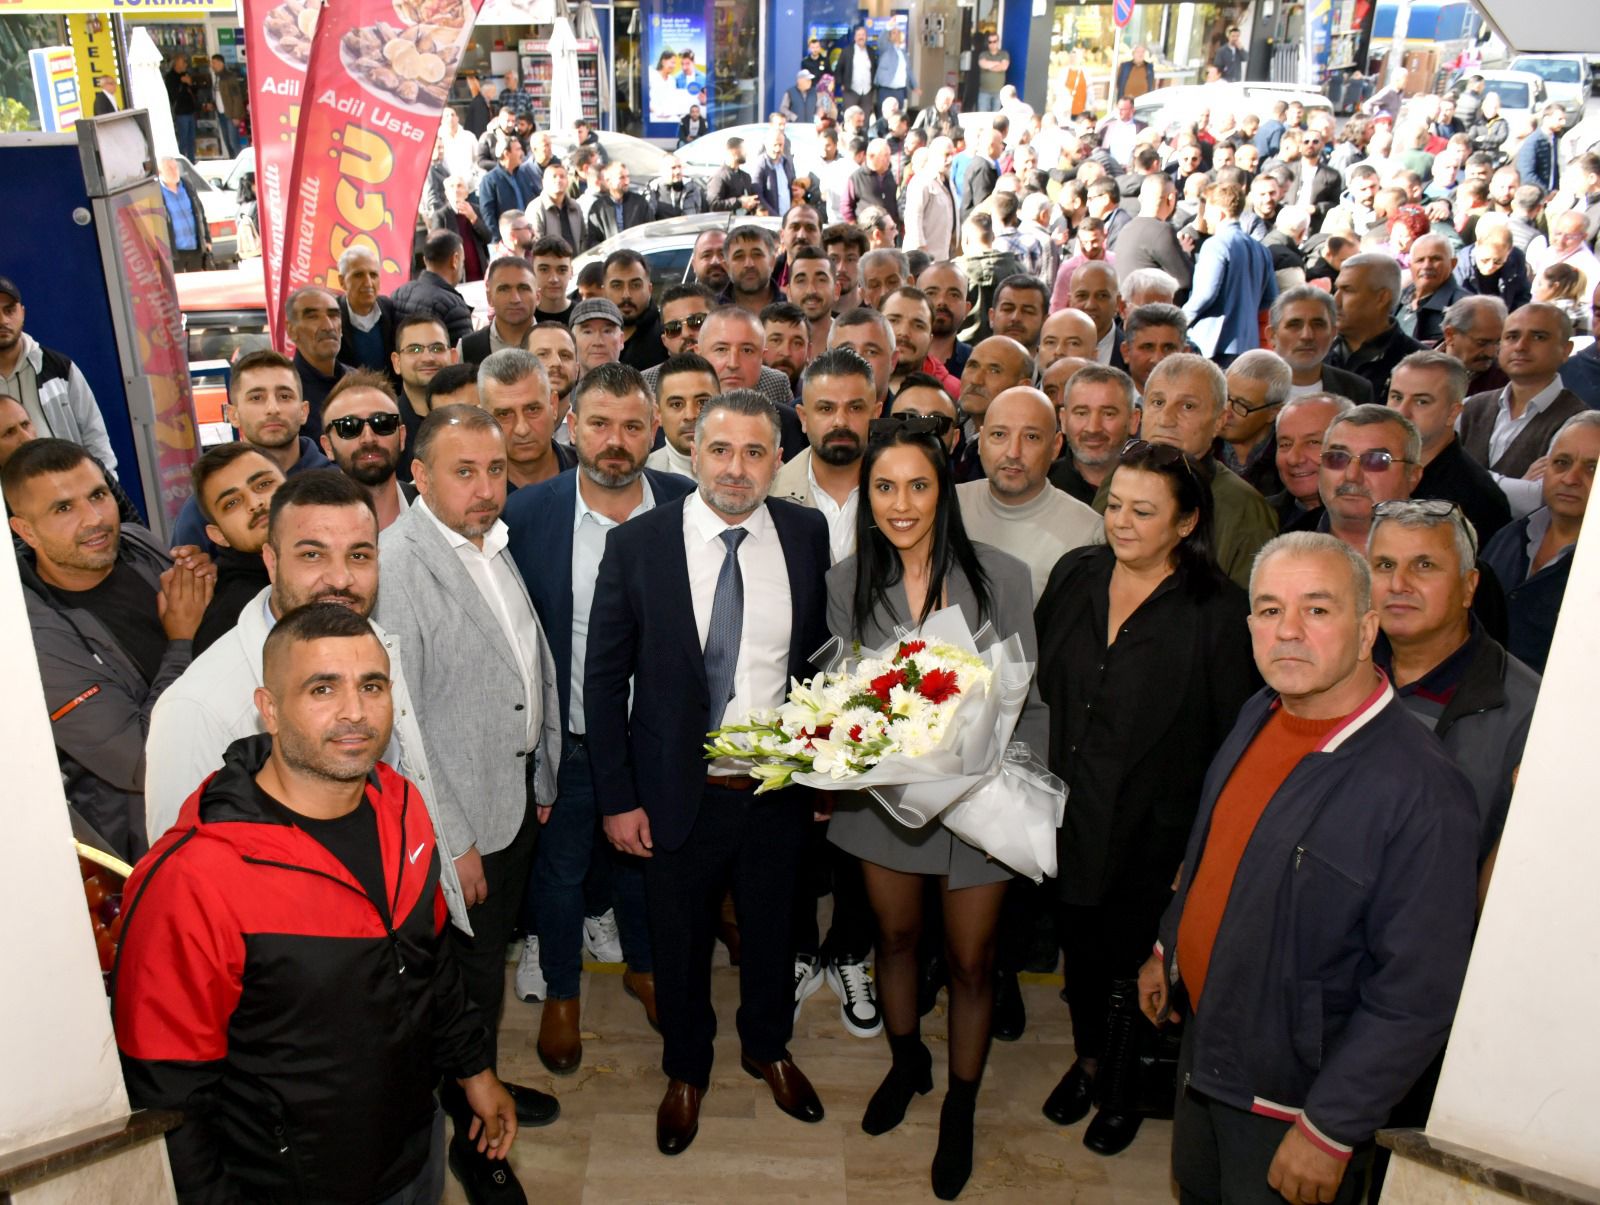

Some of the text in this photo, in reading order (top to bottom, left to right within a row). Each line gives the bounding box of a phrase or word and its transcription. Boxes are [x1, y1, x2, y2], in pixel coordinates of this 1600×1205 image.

[261, 77, 299, 96] Adil
[317, 89, 426, 143] Adil Usta
